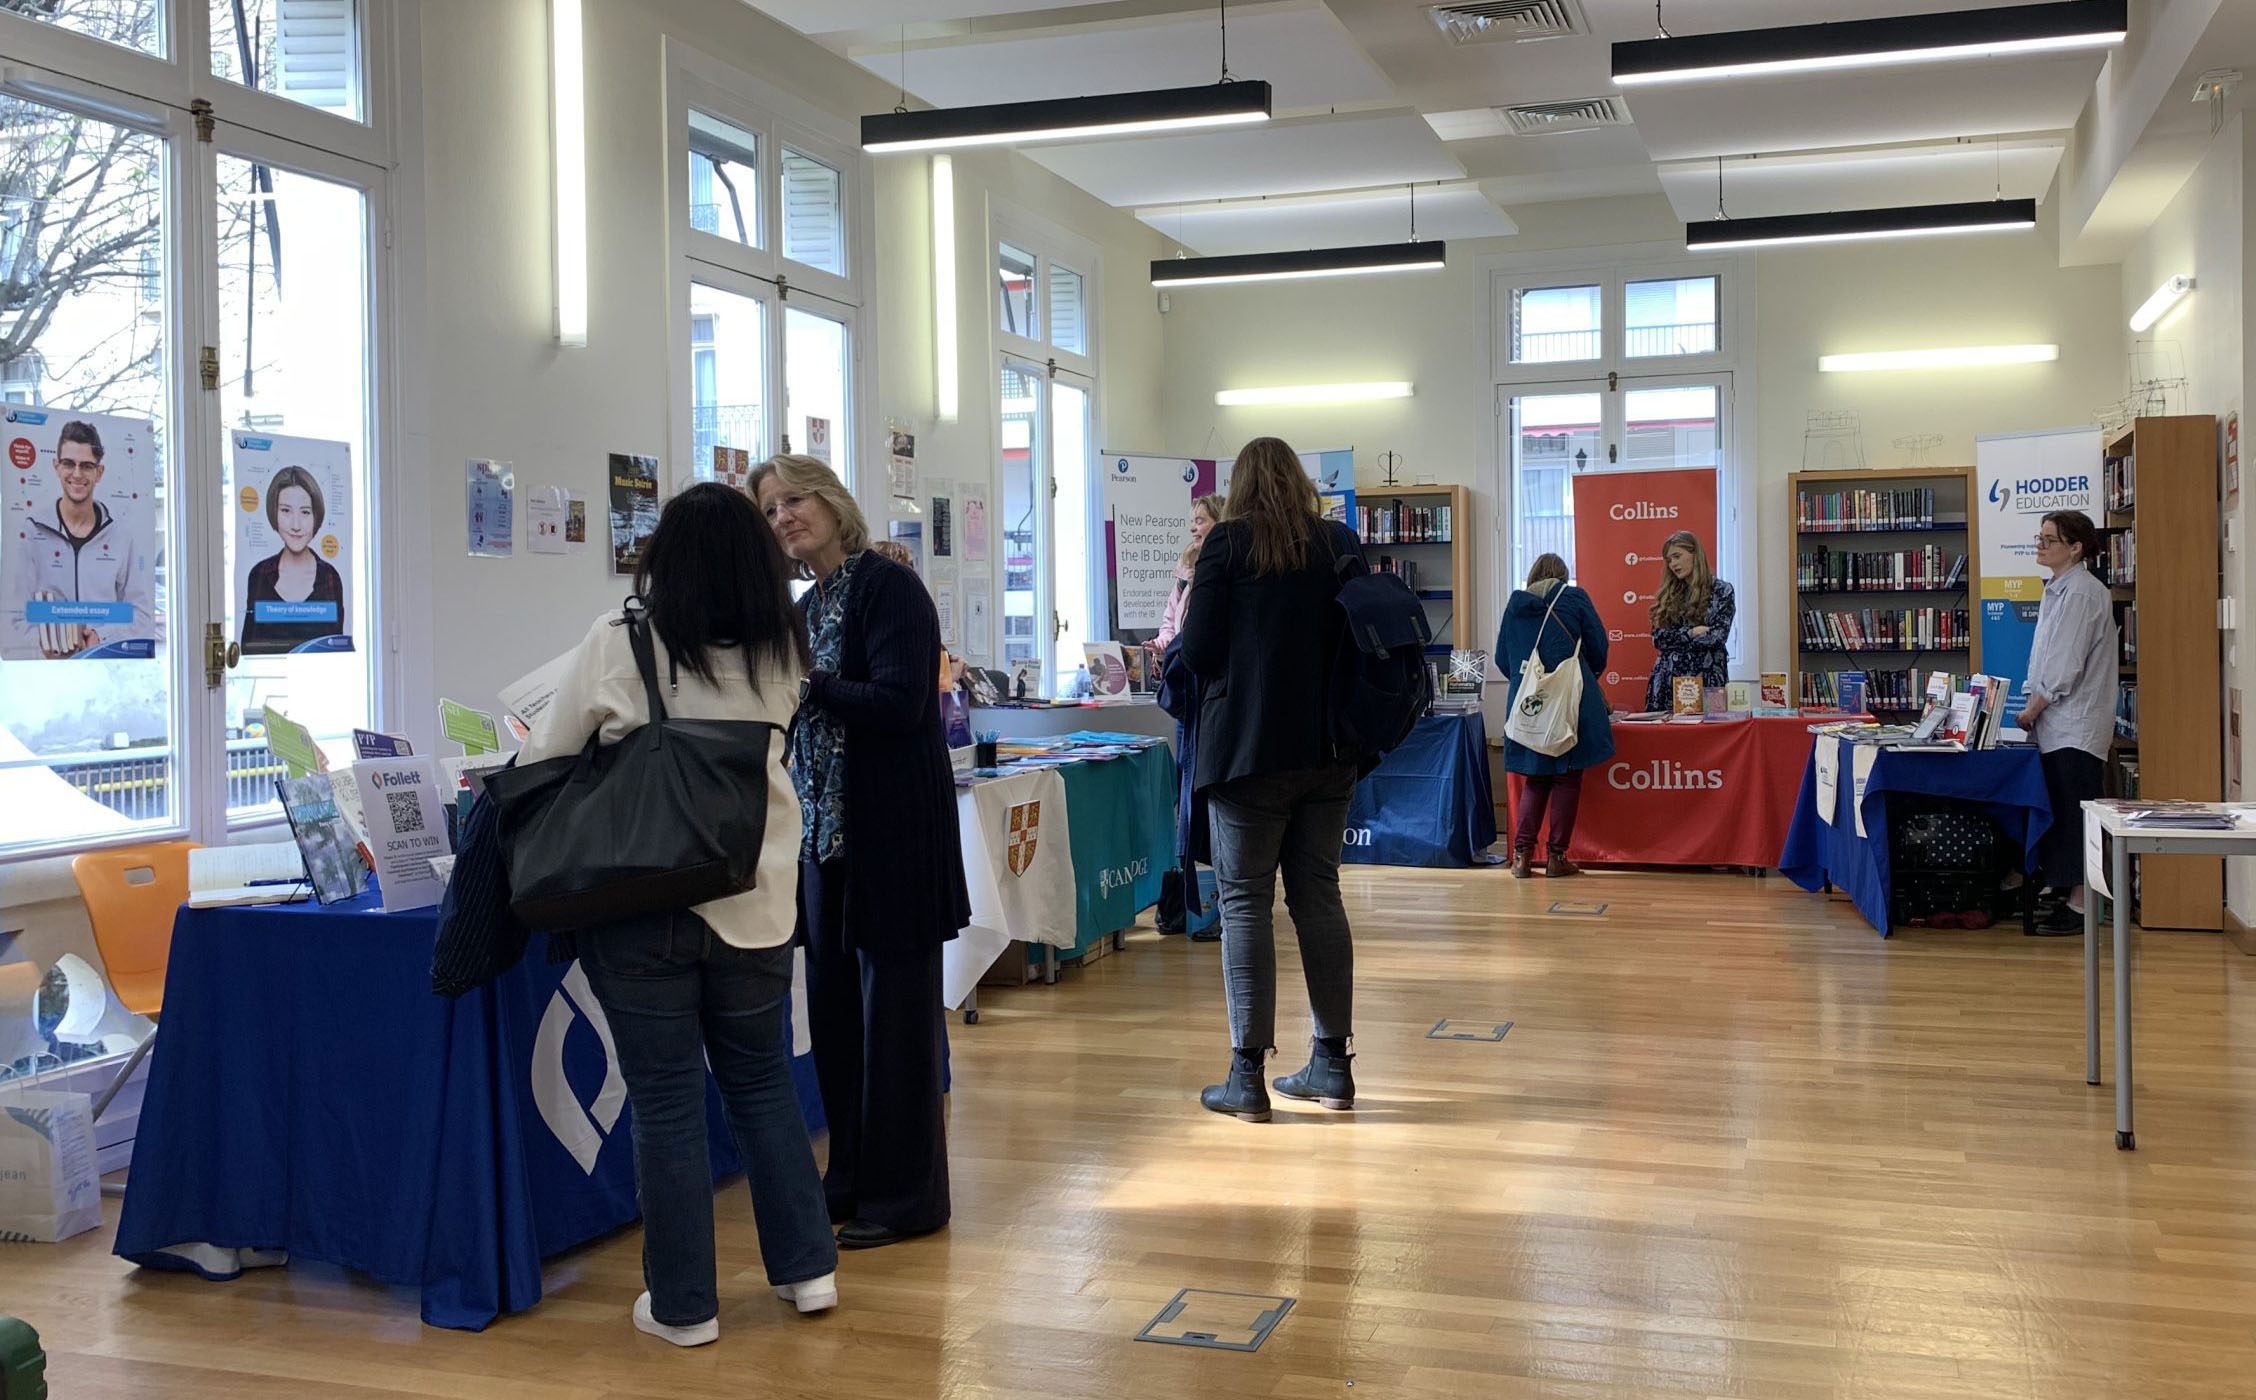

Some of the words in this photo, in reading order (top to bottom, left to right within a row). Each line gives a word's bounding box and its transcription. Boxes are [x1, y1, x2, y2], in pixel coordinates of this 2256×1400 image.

[1111, 474, 1136, 483] Pearson
[2016, 476, 2089, 494] HODDER
[2016, 493, 2090, 510] EDUCATION
[1609, 501, 1679, 521] Collins
[1120, 514, 1143, 526] New
[1145, 514, 1186, 527] Pearson
[1121, 531, 1164, 545] Sciences
[1166, 531, 1180, 545] for
[1121, 549, 1139, 562] the
[1141, 549, 1150, 562] IB
[2004, 580, 2023, 589] MYP
[1122, 588, 1152, 598] Endorsed
[266, 605, 286, 616] Theory
[287, 605, 294, 615] of
[1123, 600, 1155, 609] developed
[1987, 602, 2005, 611] MYP
[51, 605, 88, 617] Extended
[89, 606, 111, 619] essay
[1123, 610, 1137, 618] with
[1138, 610, 1148, 618] the
[383, 771, 421, 787] Follett
[1607, 759, 1723, 791] Collins
[386, 839, 409, 852] SCAN
[409, 838, 422, 848] TO
[422, 836, 440, 847] WIN
